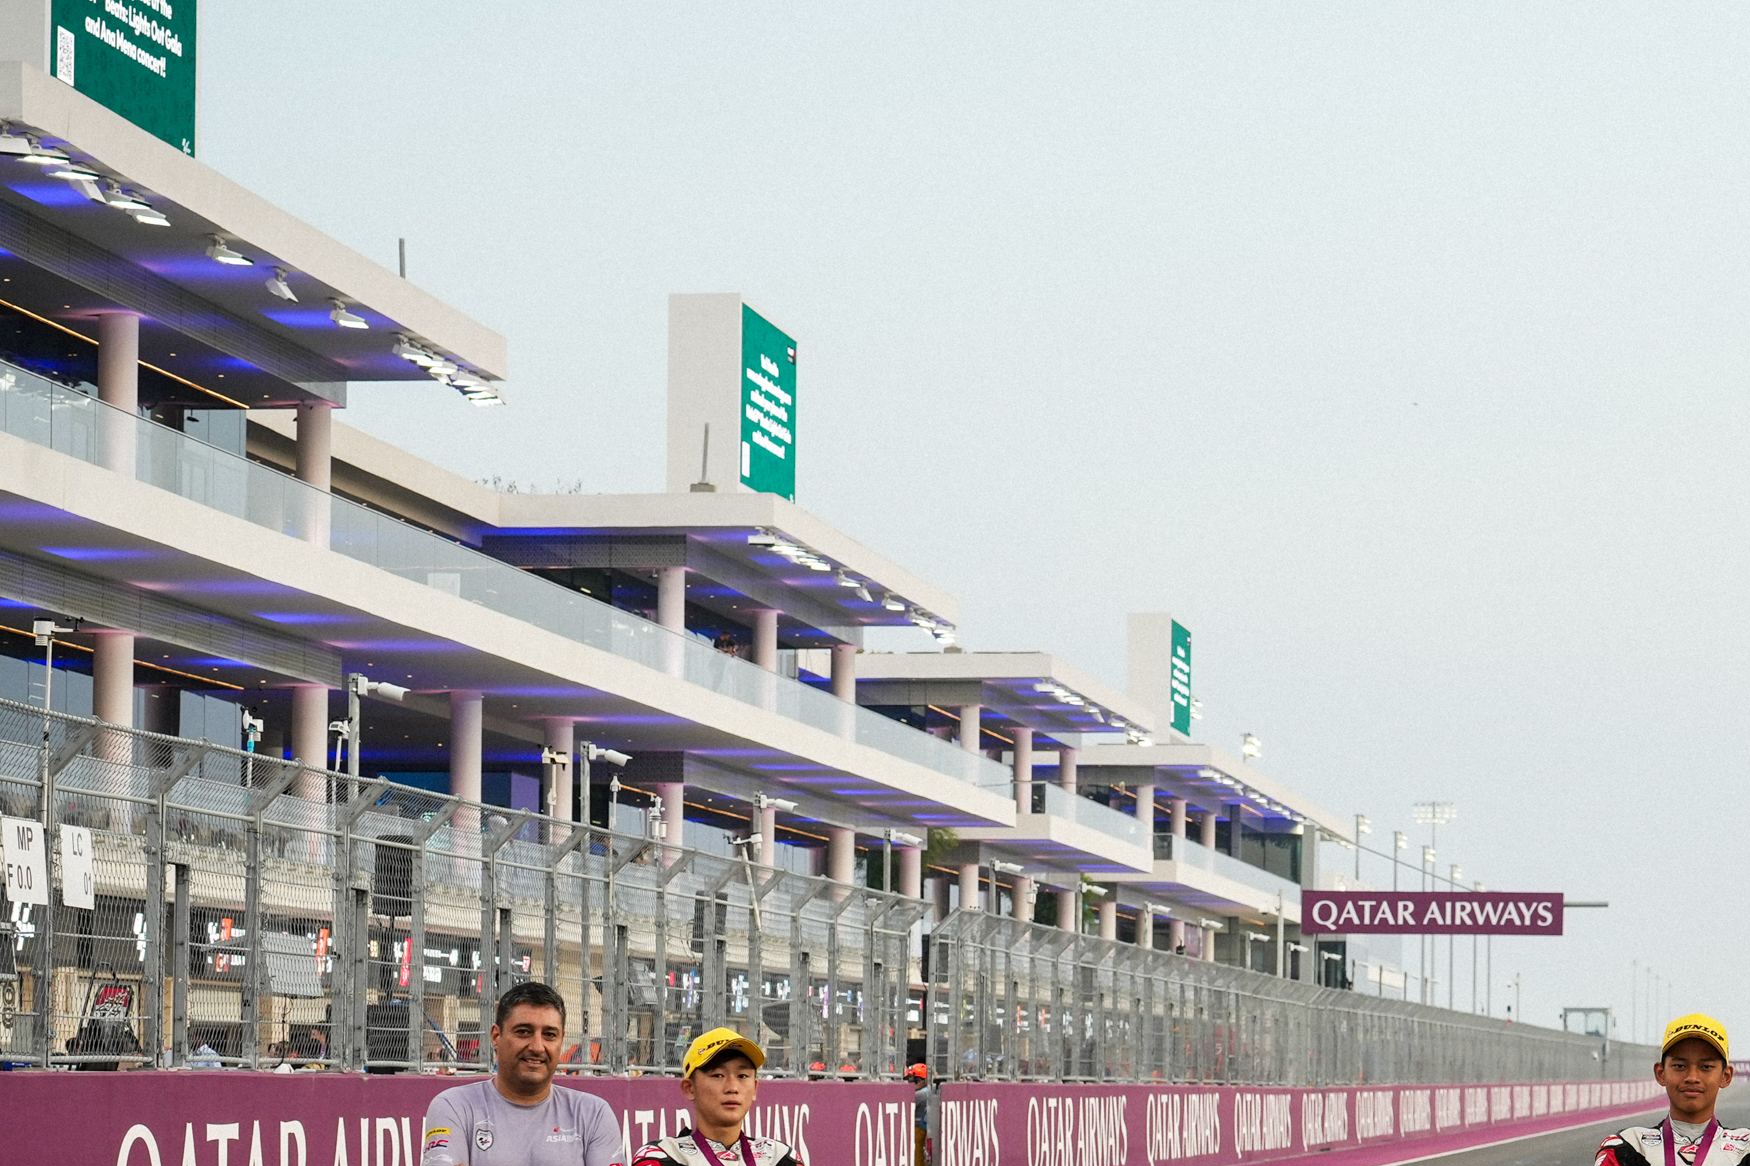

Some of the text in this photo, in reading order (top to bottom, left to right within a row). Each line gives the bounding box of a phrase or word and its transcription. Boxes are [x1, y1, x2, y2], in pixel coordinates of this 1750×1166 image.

[85, 16, 100, 38] and
[100, 20, 115, 47] Ana
[116, 29, 137, 60] Mena
[128, 5, 151, 37] Lights
[150, 20, 165, 46] Out
[165, 29, 182, 57] Gala
[17, 825, 33, 851] MP
[71, 832, 83, 857] LC
[1312, 900, 1553, 930] QATAR AIRWAYS
[1673, 1024, 1724, 1042] DUNLOP
[1182, 1093, 1220, 1158] AIRWAYS
